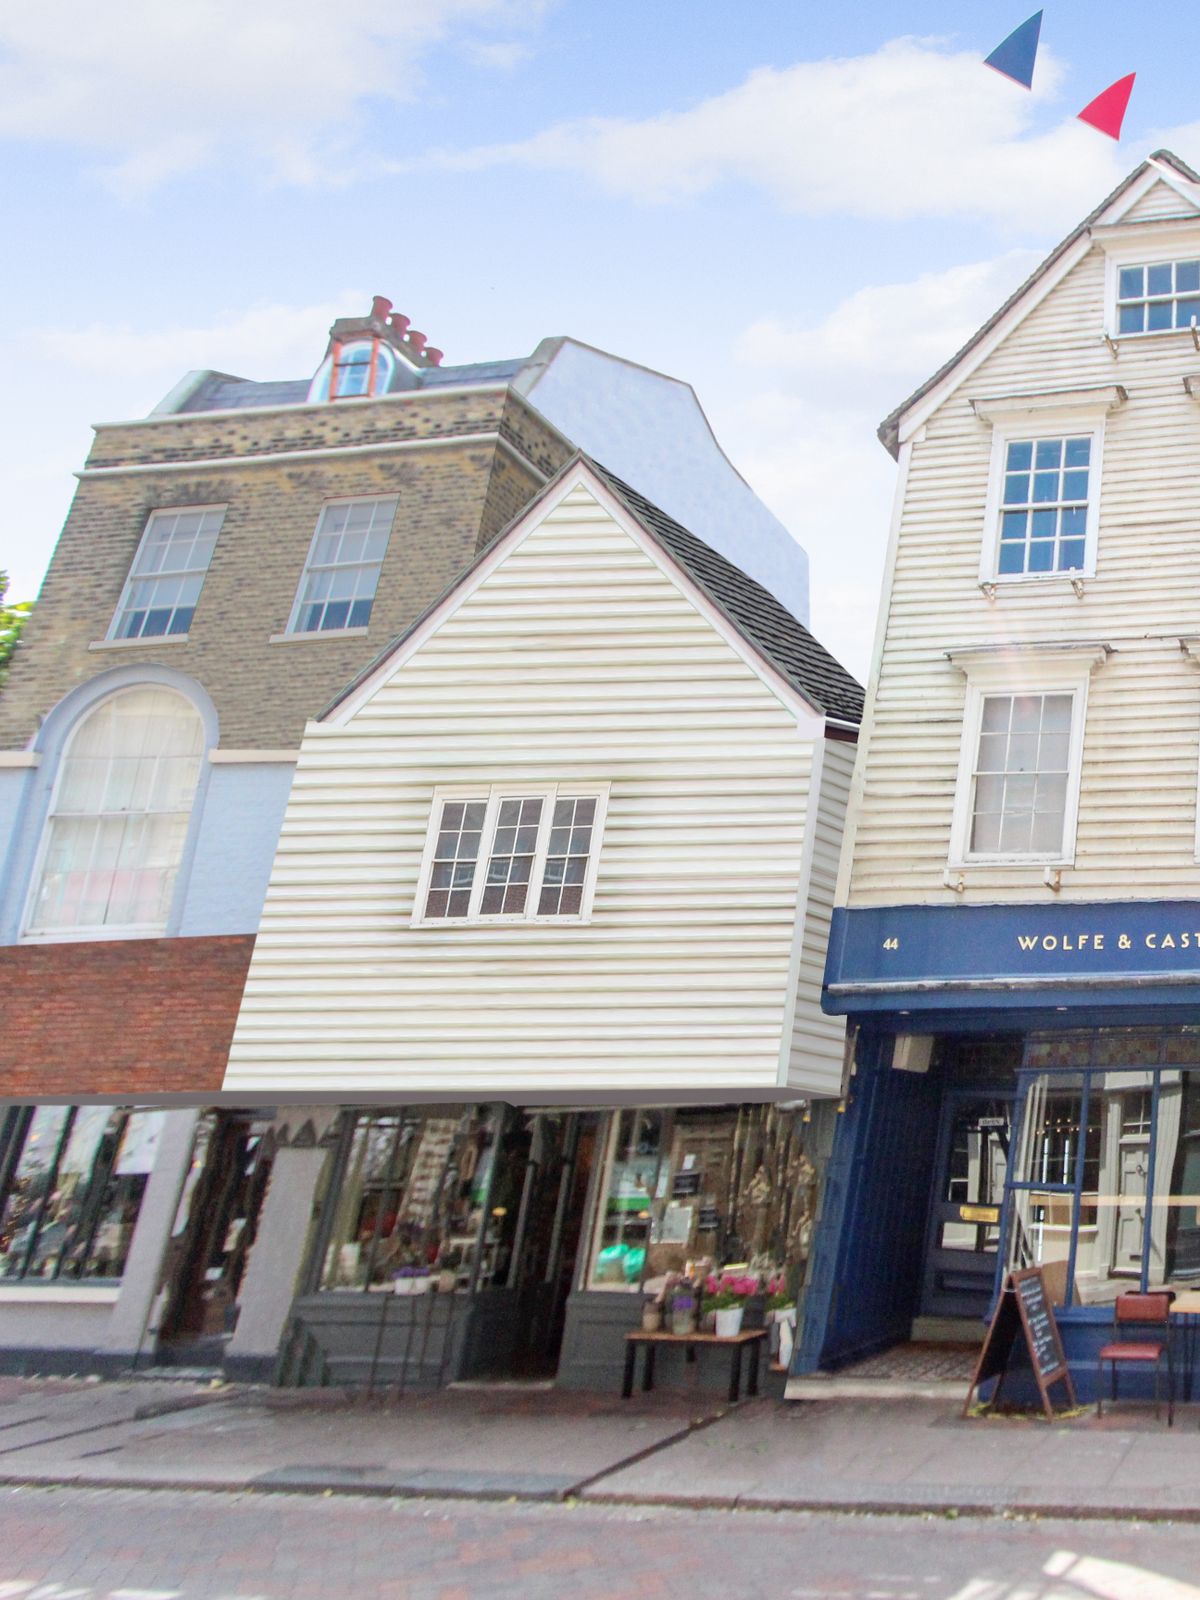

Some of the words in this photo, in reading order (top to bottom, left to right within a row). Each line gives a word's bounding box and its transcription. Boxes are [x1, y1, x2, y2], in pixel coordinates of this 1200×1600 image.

[882, 937, 899, 950] 44
[1017, 935, 1105, 951] WOLFE
[1117, 933, 1133, 950] &
